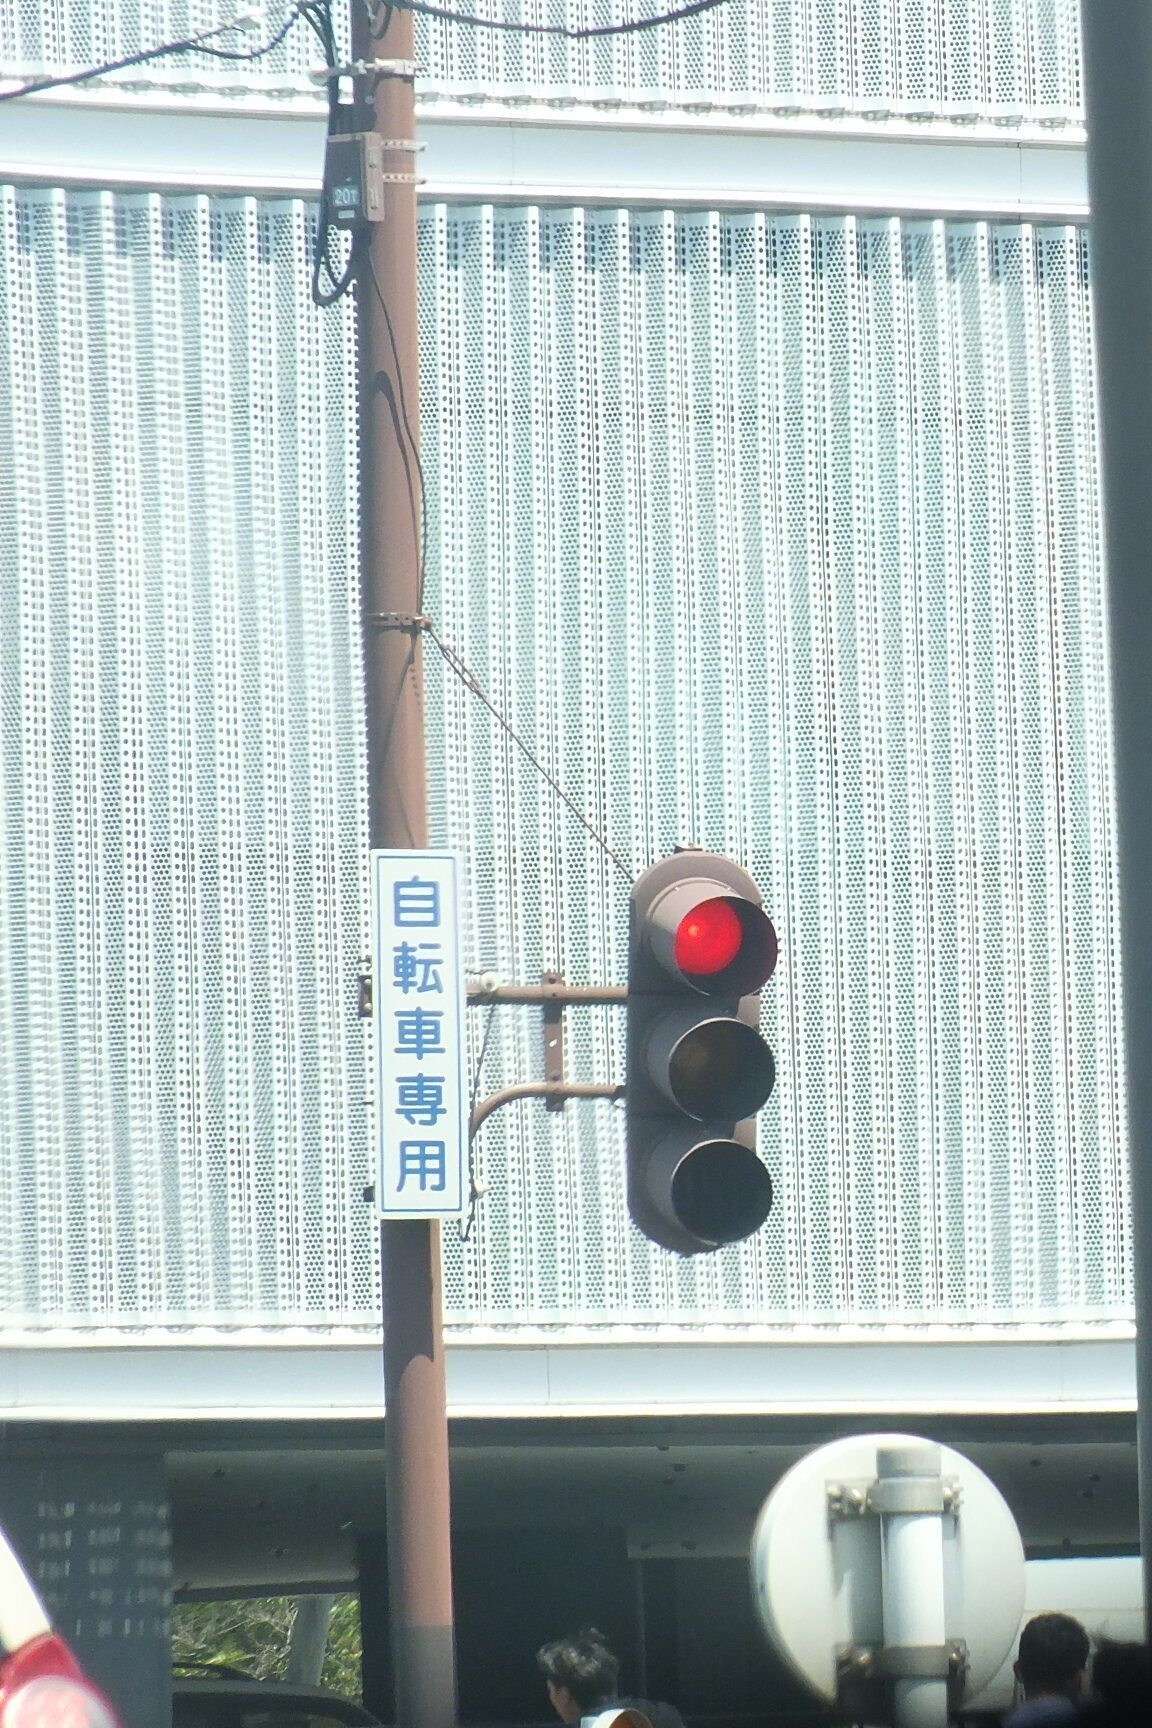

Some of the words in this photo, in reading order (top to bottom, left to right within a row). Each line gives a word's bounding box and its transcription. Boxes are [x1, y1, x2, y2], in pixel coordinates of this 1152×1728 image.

[392, 875, 447, 1193] 自転車専用
